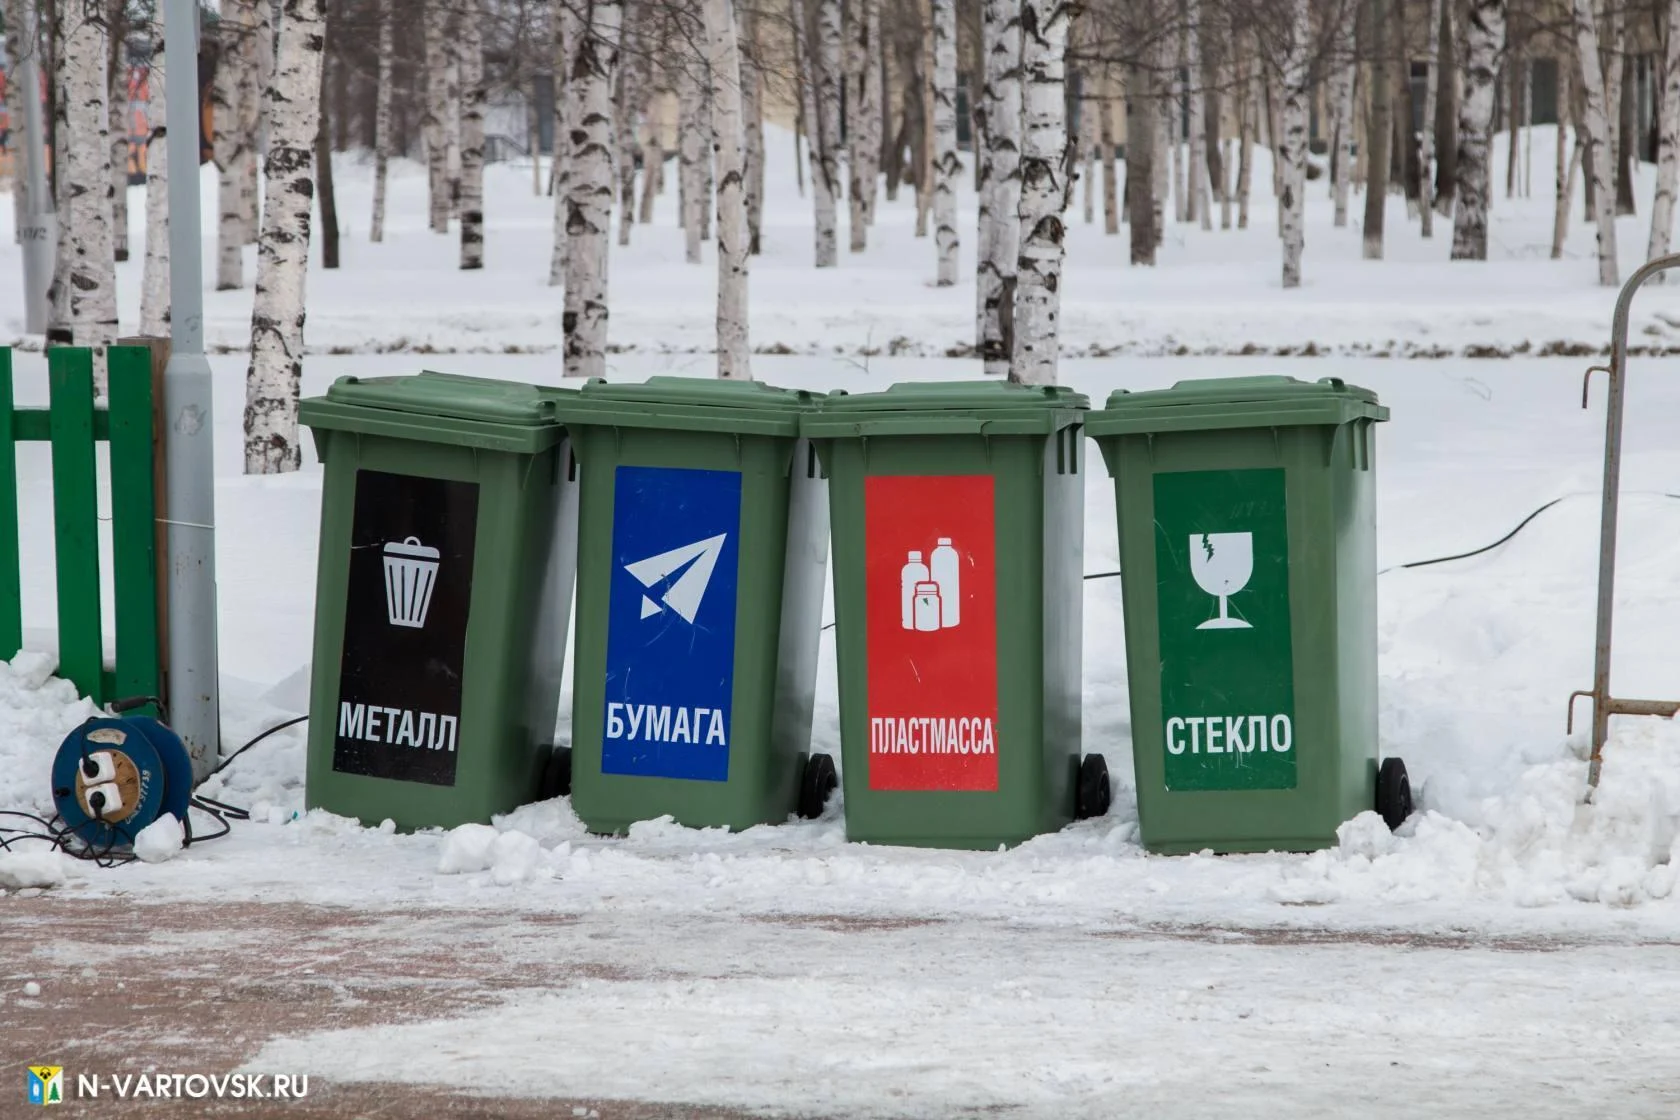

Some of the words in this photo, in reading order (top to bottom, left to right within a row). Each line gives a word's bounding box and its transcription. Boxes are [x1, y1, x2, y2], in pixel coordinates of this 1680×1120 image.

[340, 702, 456, 751] МЕТАЛЛ
[607, 703, 725, 745] БУМАГА
[872, 717, 994, 754] ПЛАСТМАССА
[1167, 714, 1291, 754] СТЕКЛО
